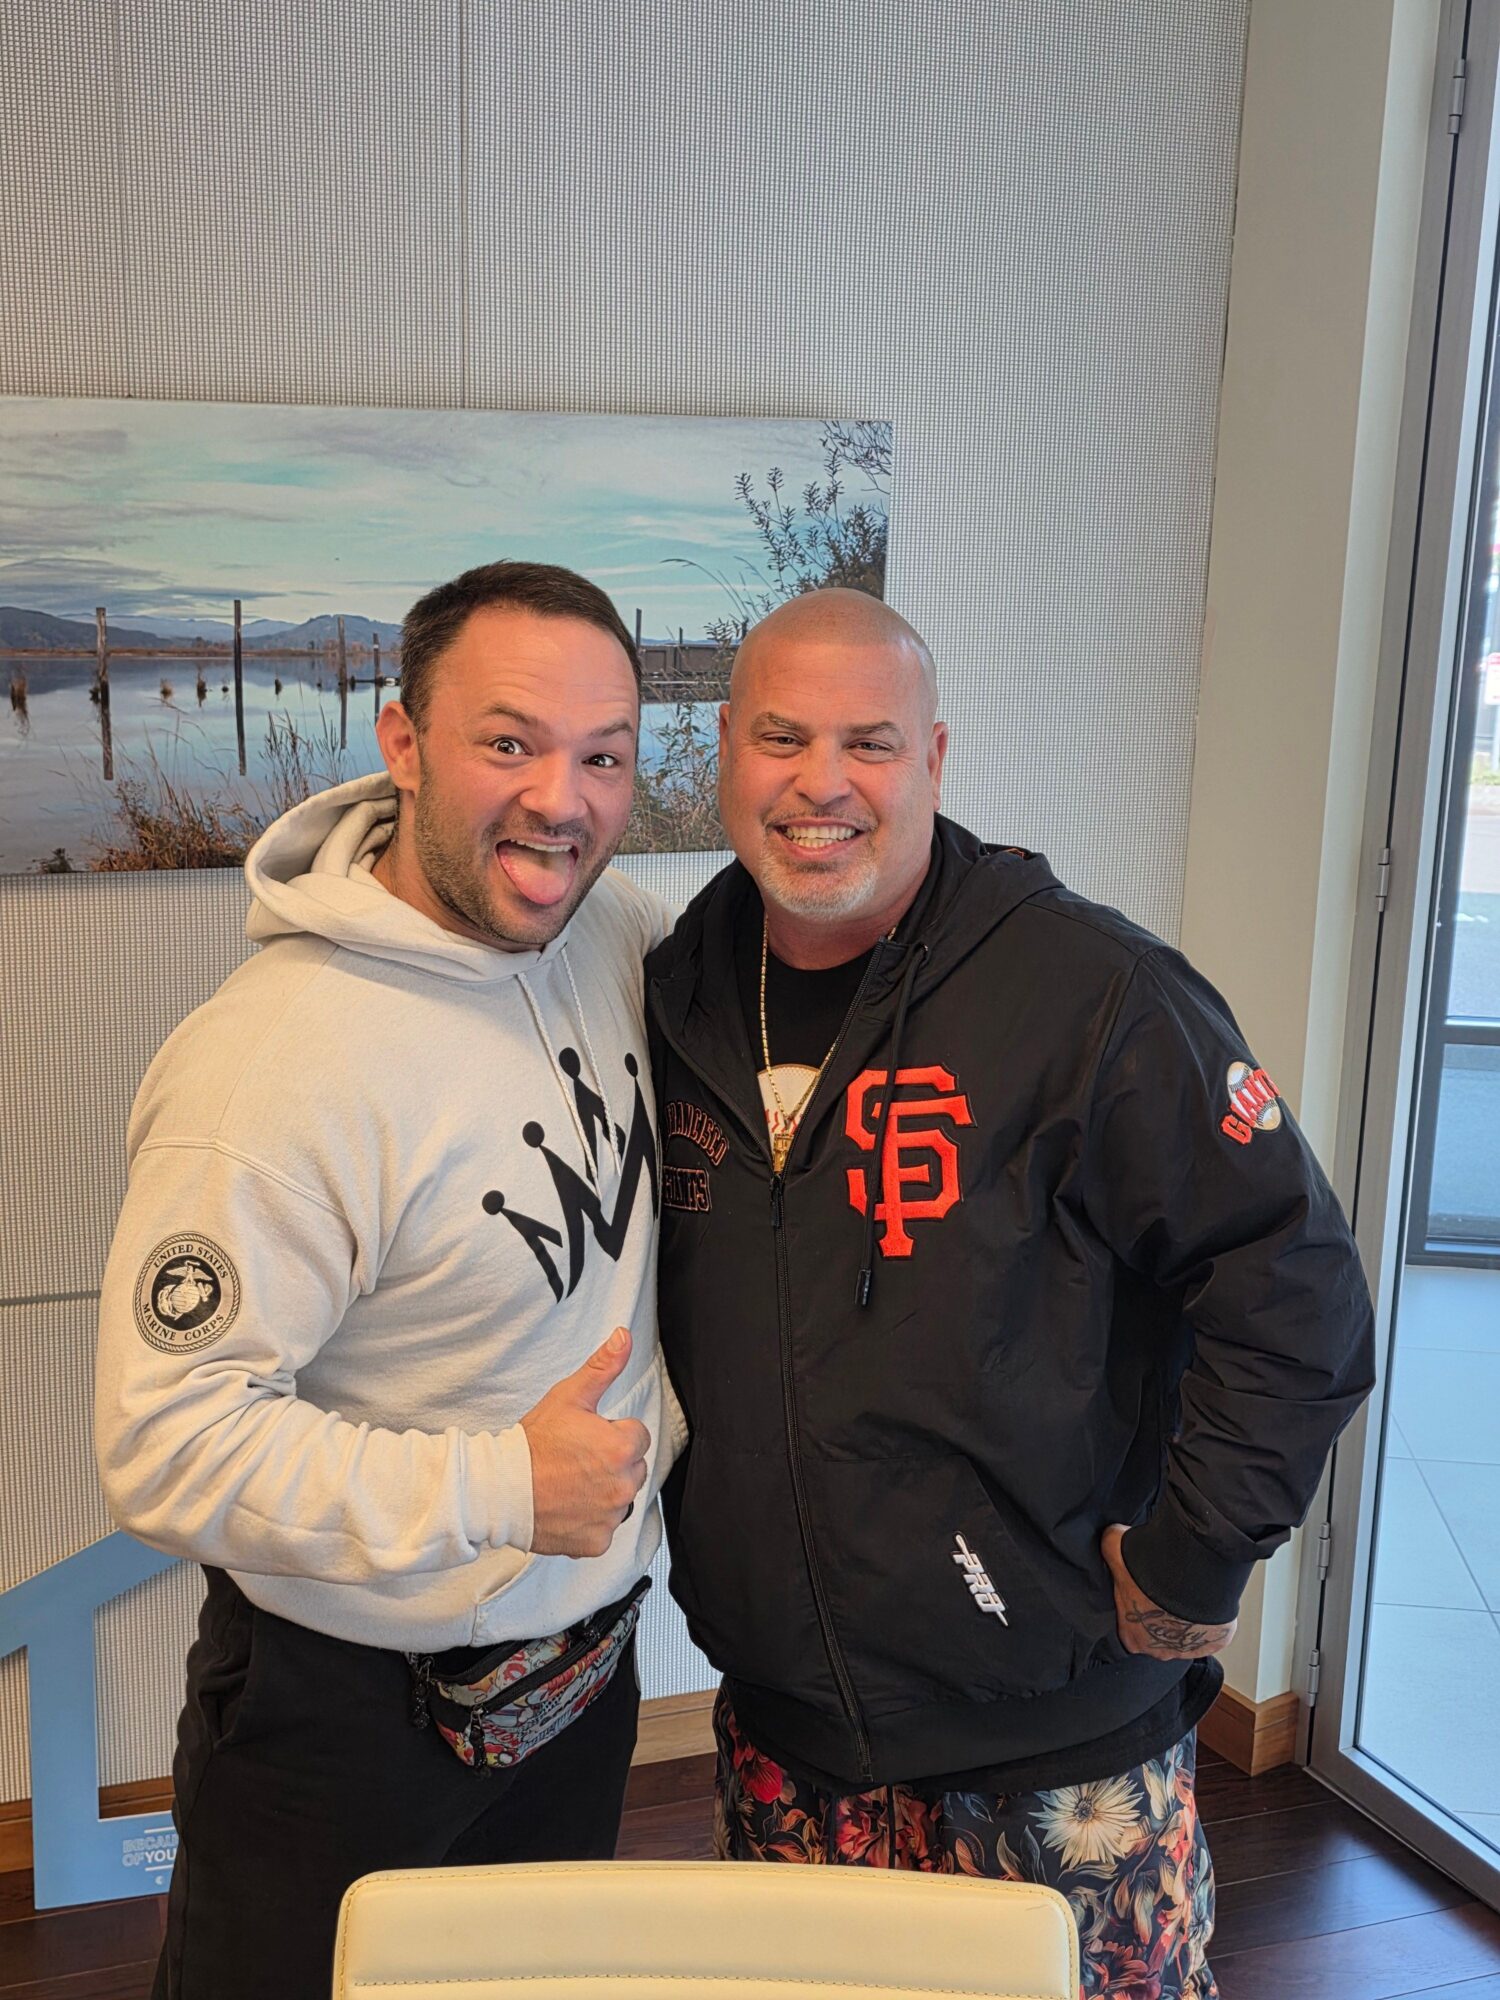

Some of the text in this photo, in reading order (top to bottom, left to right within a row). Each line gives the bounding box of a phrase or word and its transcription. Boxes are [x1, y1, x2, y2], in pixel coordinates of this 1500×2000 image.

[1221, 1068, 1280, 1144] GIANT
[154, 1244, 229, 1279] UNITED STATES
[143, 1302, 224, 1341] MARINE CORPS
